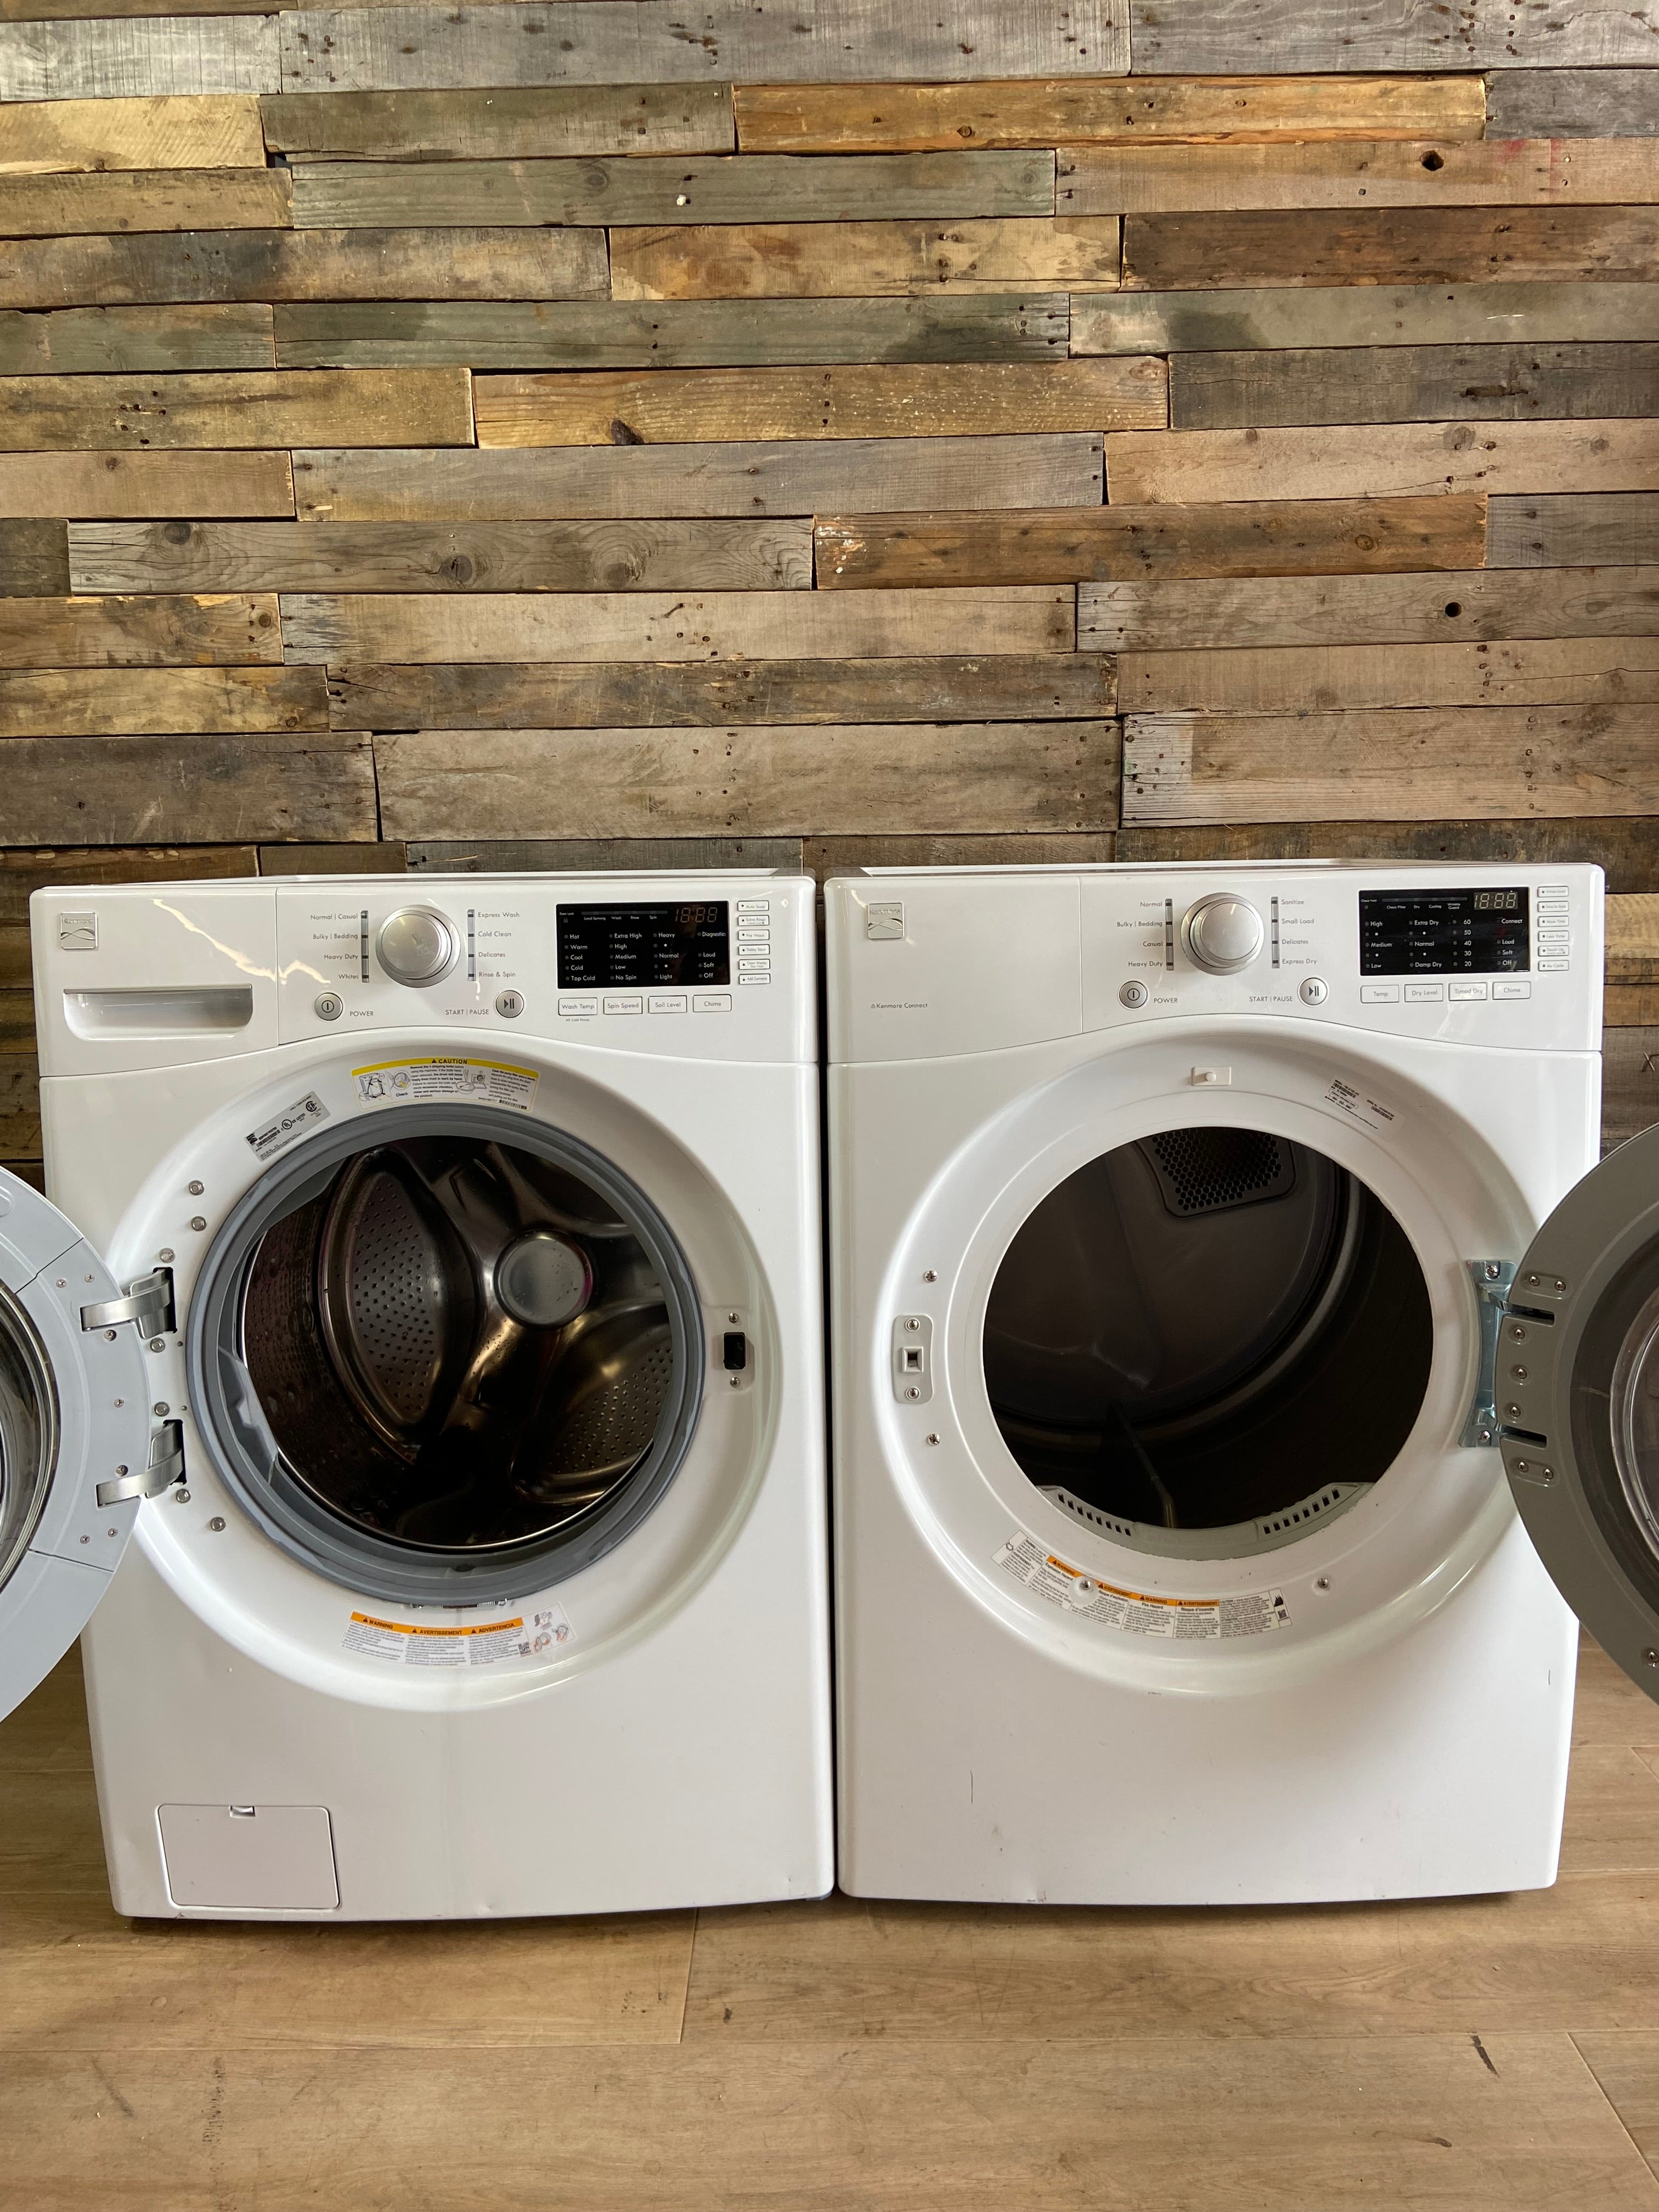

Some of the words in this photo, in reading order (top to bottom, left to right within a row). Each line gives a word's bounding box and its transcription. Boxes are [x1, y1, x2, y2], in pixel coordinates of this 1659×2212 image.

[1045, 1562, 1061, 1575] Explosion
[1061, 1572, 1074, 1581] Hazard
[369, 1619, 393, 1629] WARNING
[478, 1623, 515, 1633] ADVERTENCIA
